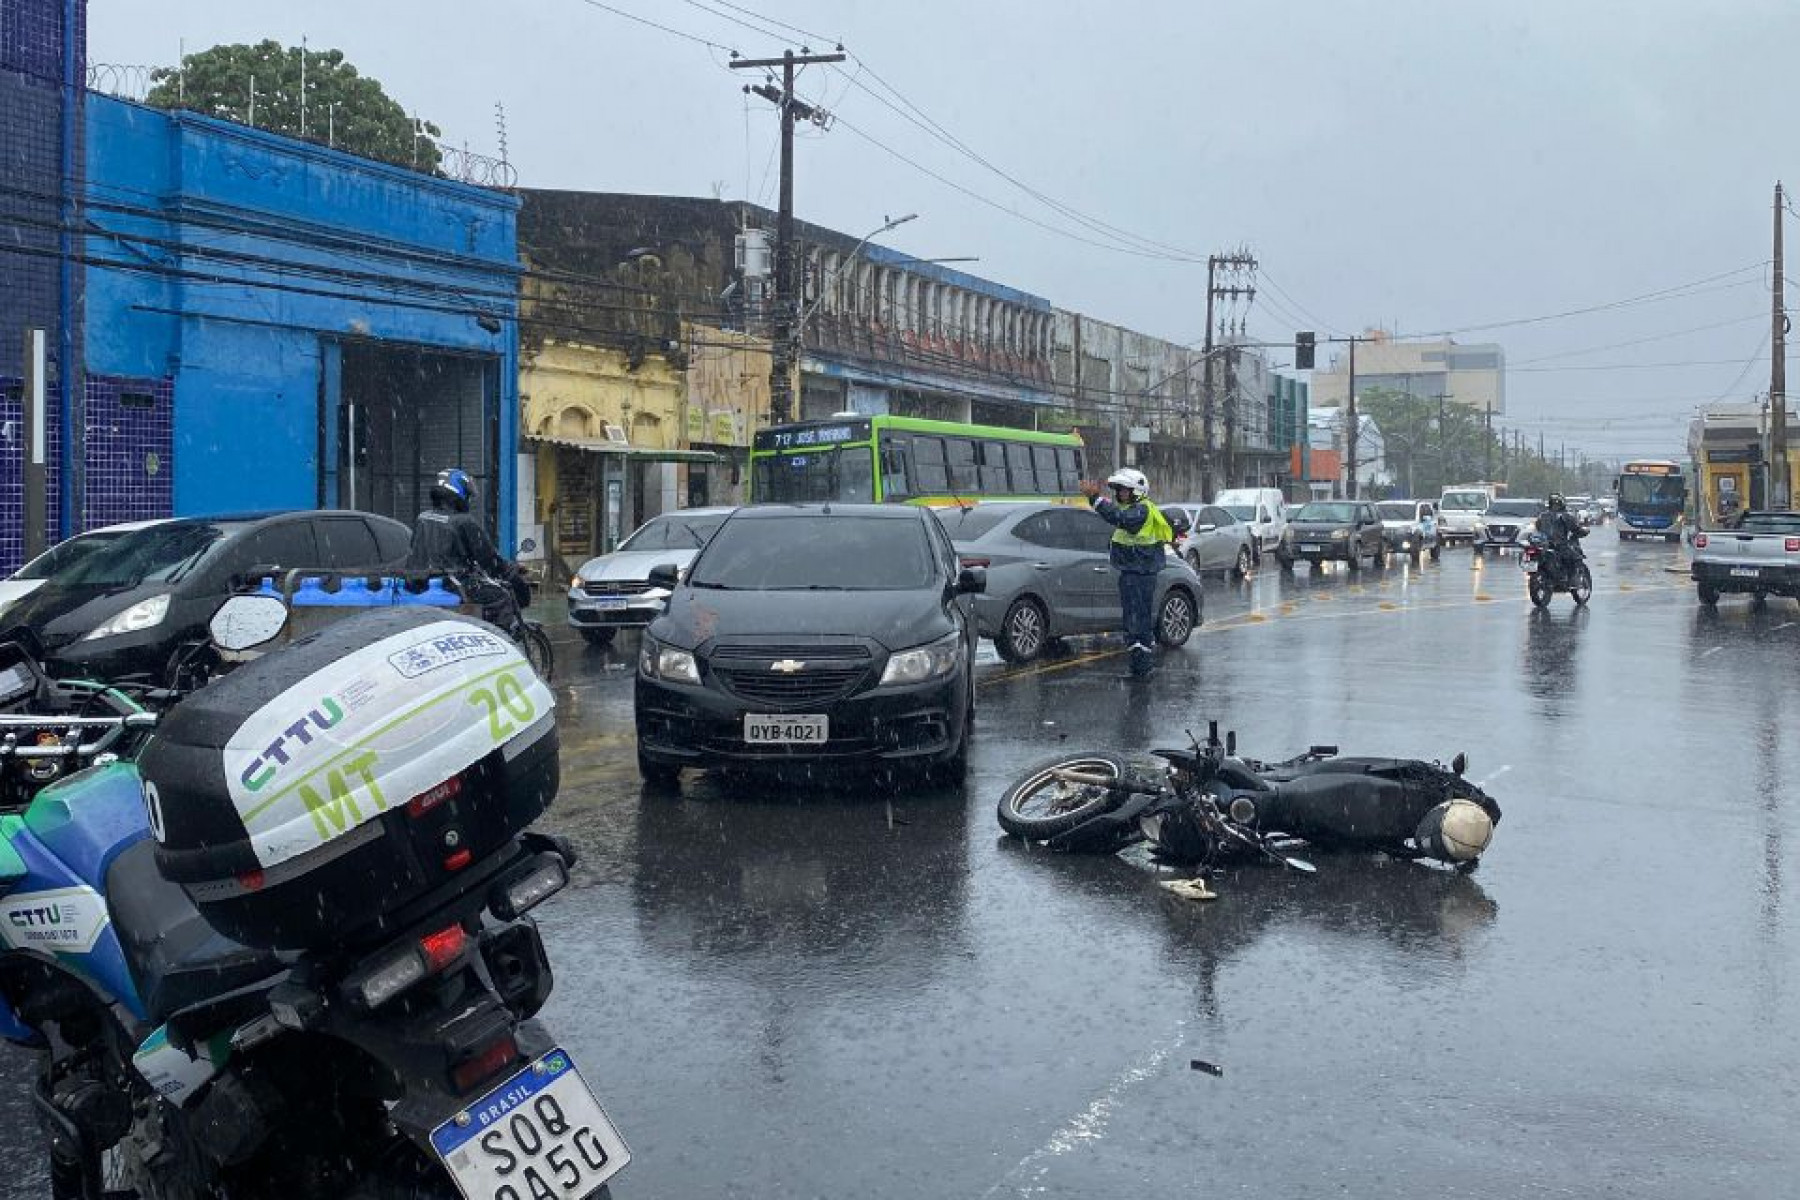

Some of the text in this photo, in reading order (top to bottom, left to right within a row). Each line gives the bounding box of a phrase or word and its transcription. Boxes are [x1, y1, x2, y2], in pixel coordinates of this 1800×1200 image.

[432, 634, 498, 655] RECIFE
[467, 672, 535, 743] 20
[241, 697, 344, 792] CTTU
[300, 751, 388, 841] MT
[9, 904, 60, 926] CTTU
[478, 1085, 533, 1126] BRASIL
[481, 1094, 571, 1175] SOQ
